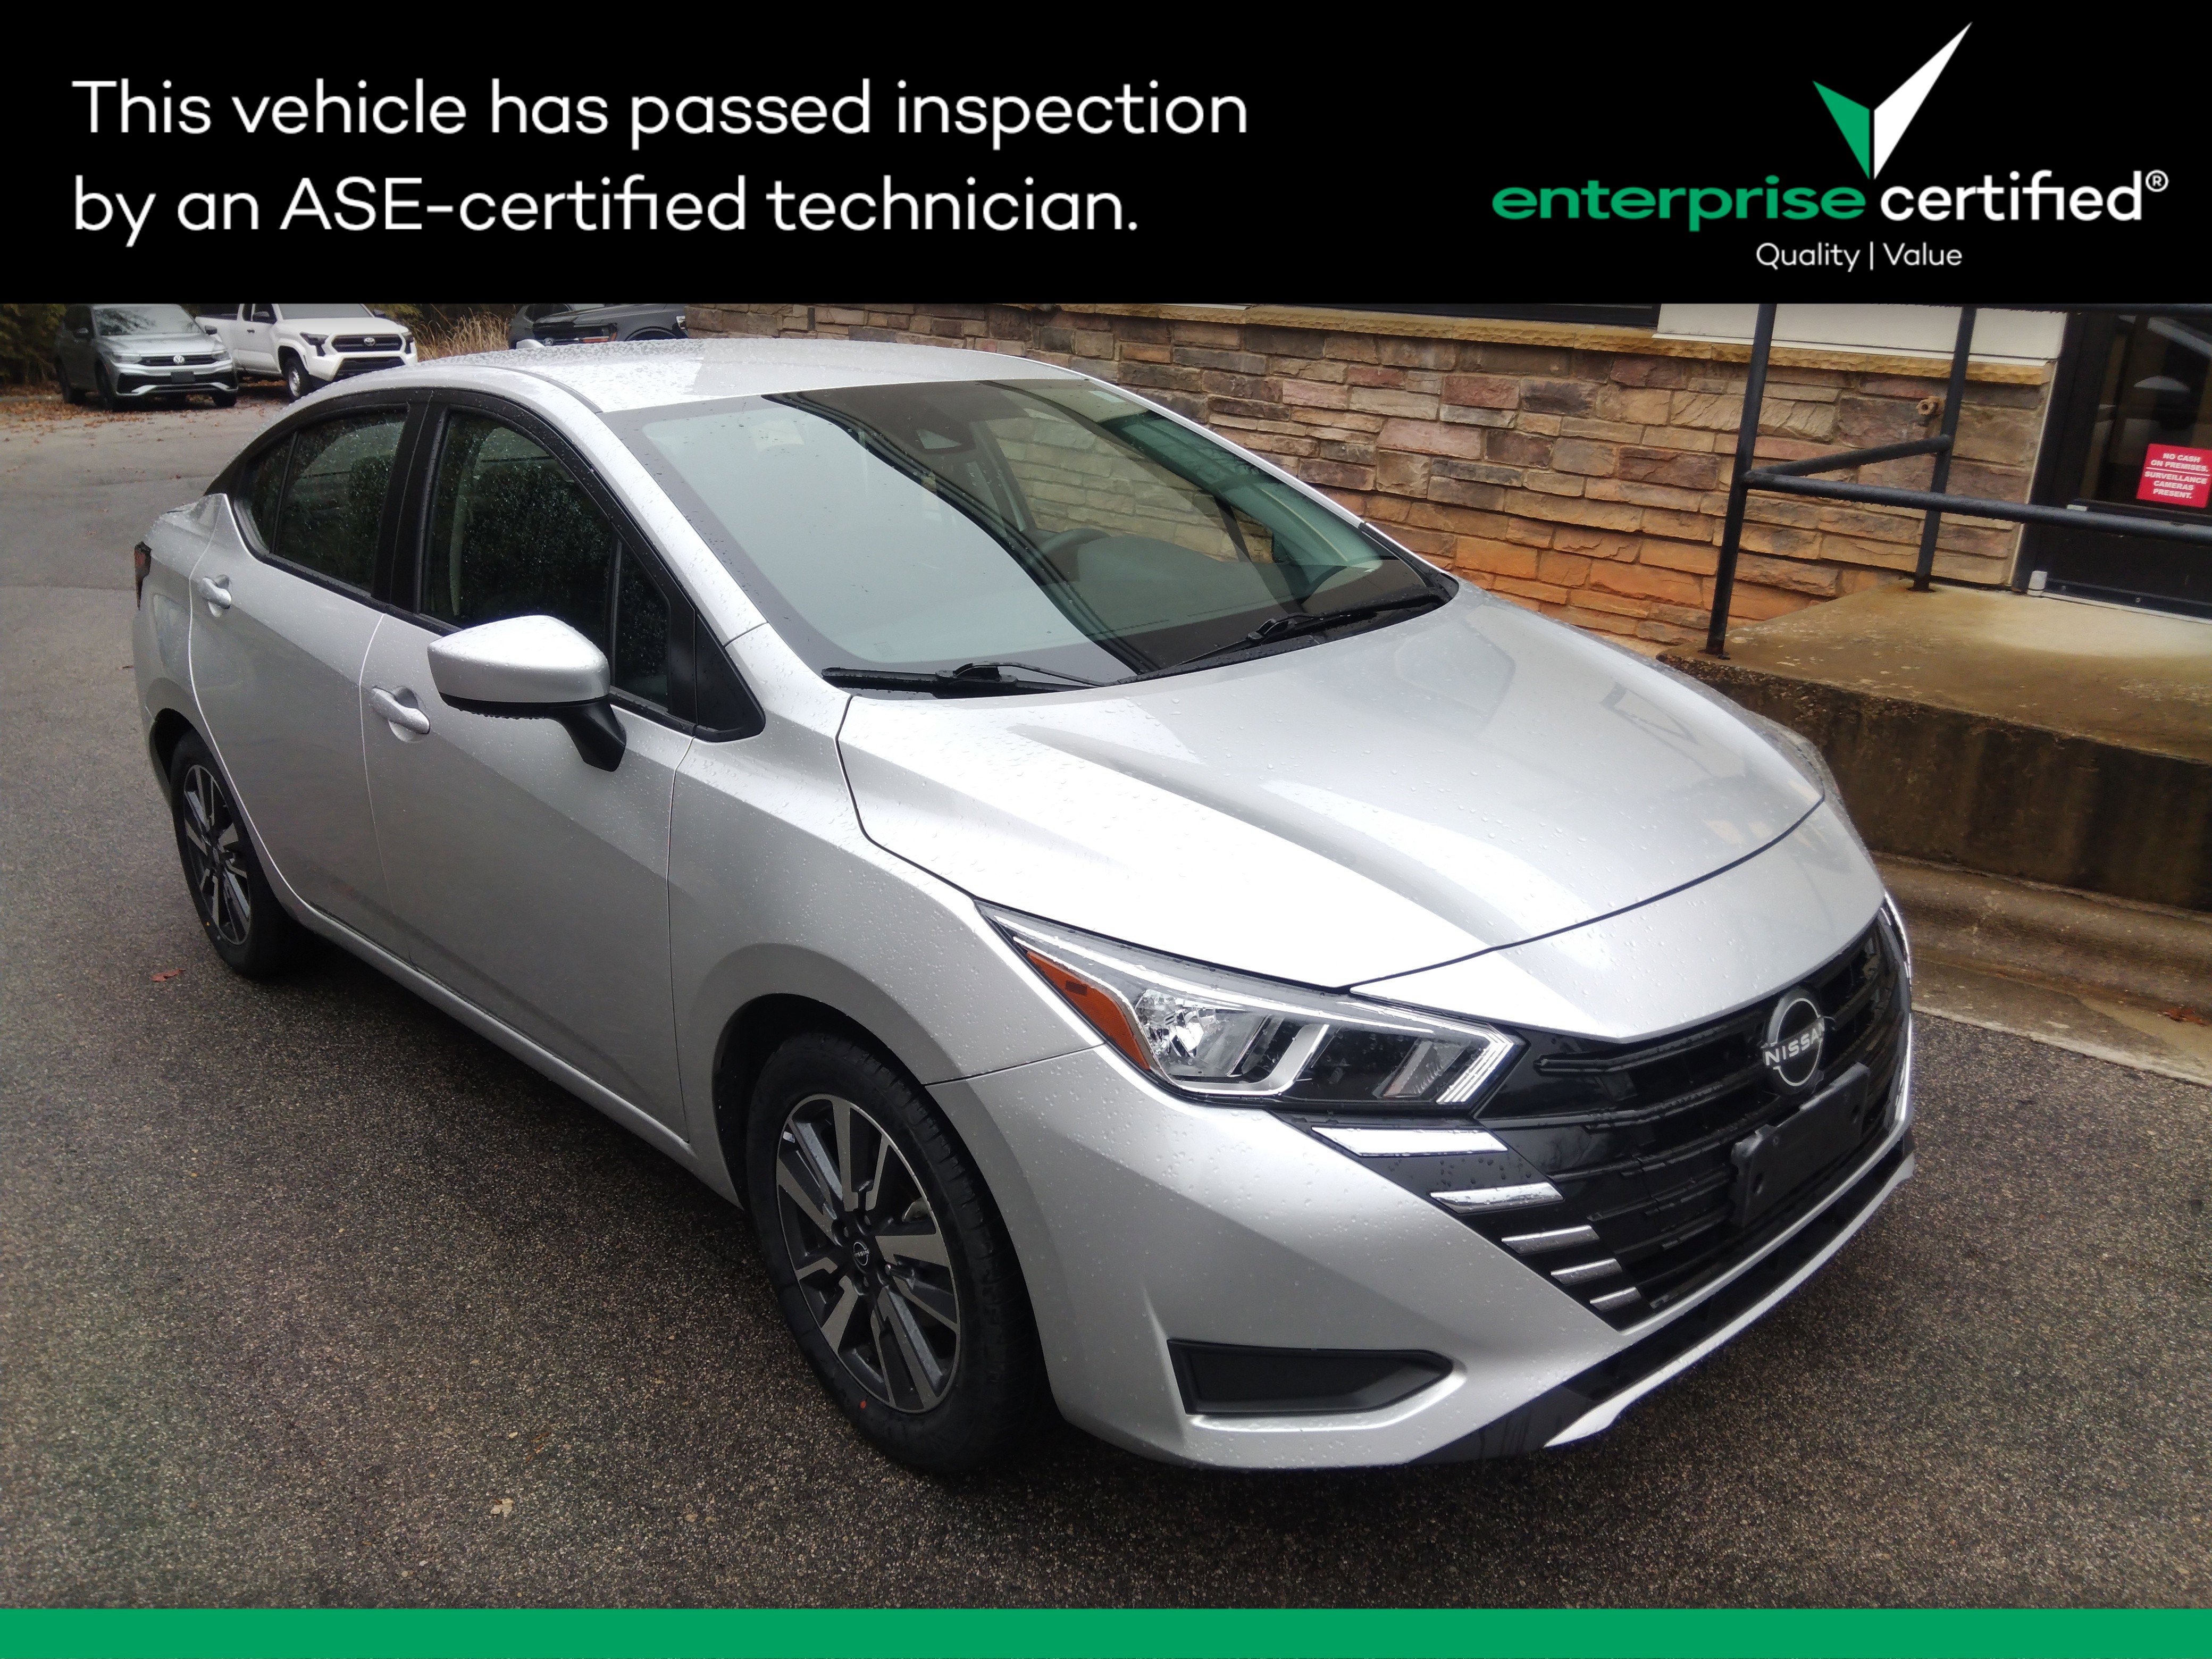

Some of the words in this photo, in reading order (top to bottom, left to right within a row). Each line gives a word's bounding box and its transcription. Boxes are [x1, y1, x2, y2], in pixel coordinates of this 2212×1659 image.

[2165, 461, 2209, 472] PREMISES.
[2144, 471, 2208, 484] SURVEILLANCE
[2154, 480, 2194, 491] CAMERAS
[2153, 488, 2192, 499] PRESENT.
[1764, 1023, 1825, 1066] NISSAN
